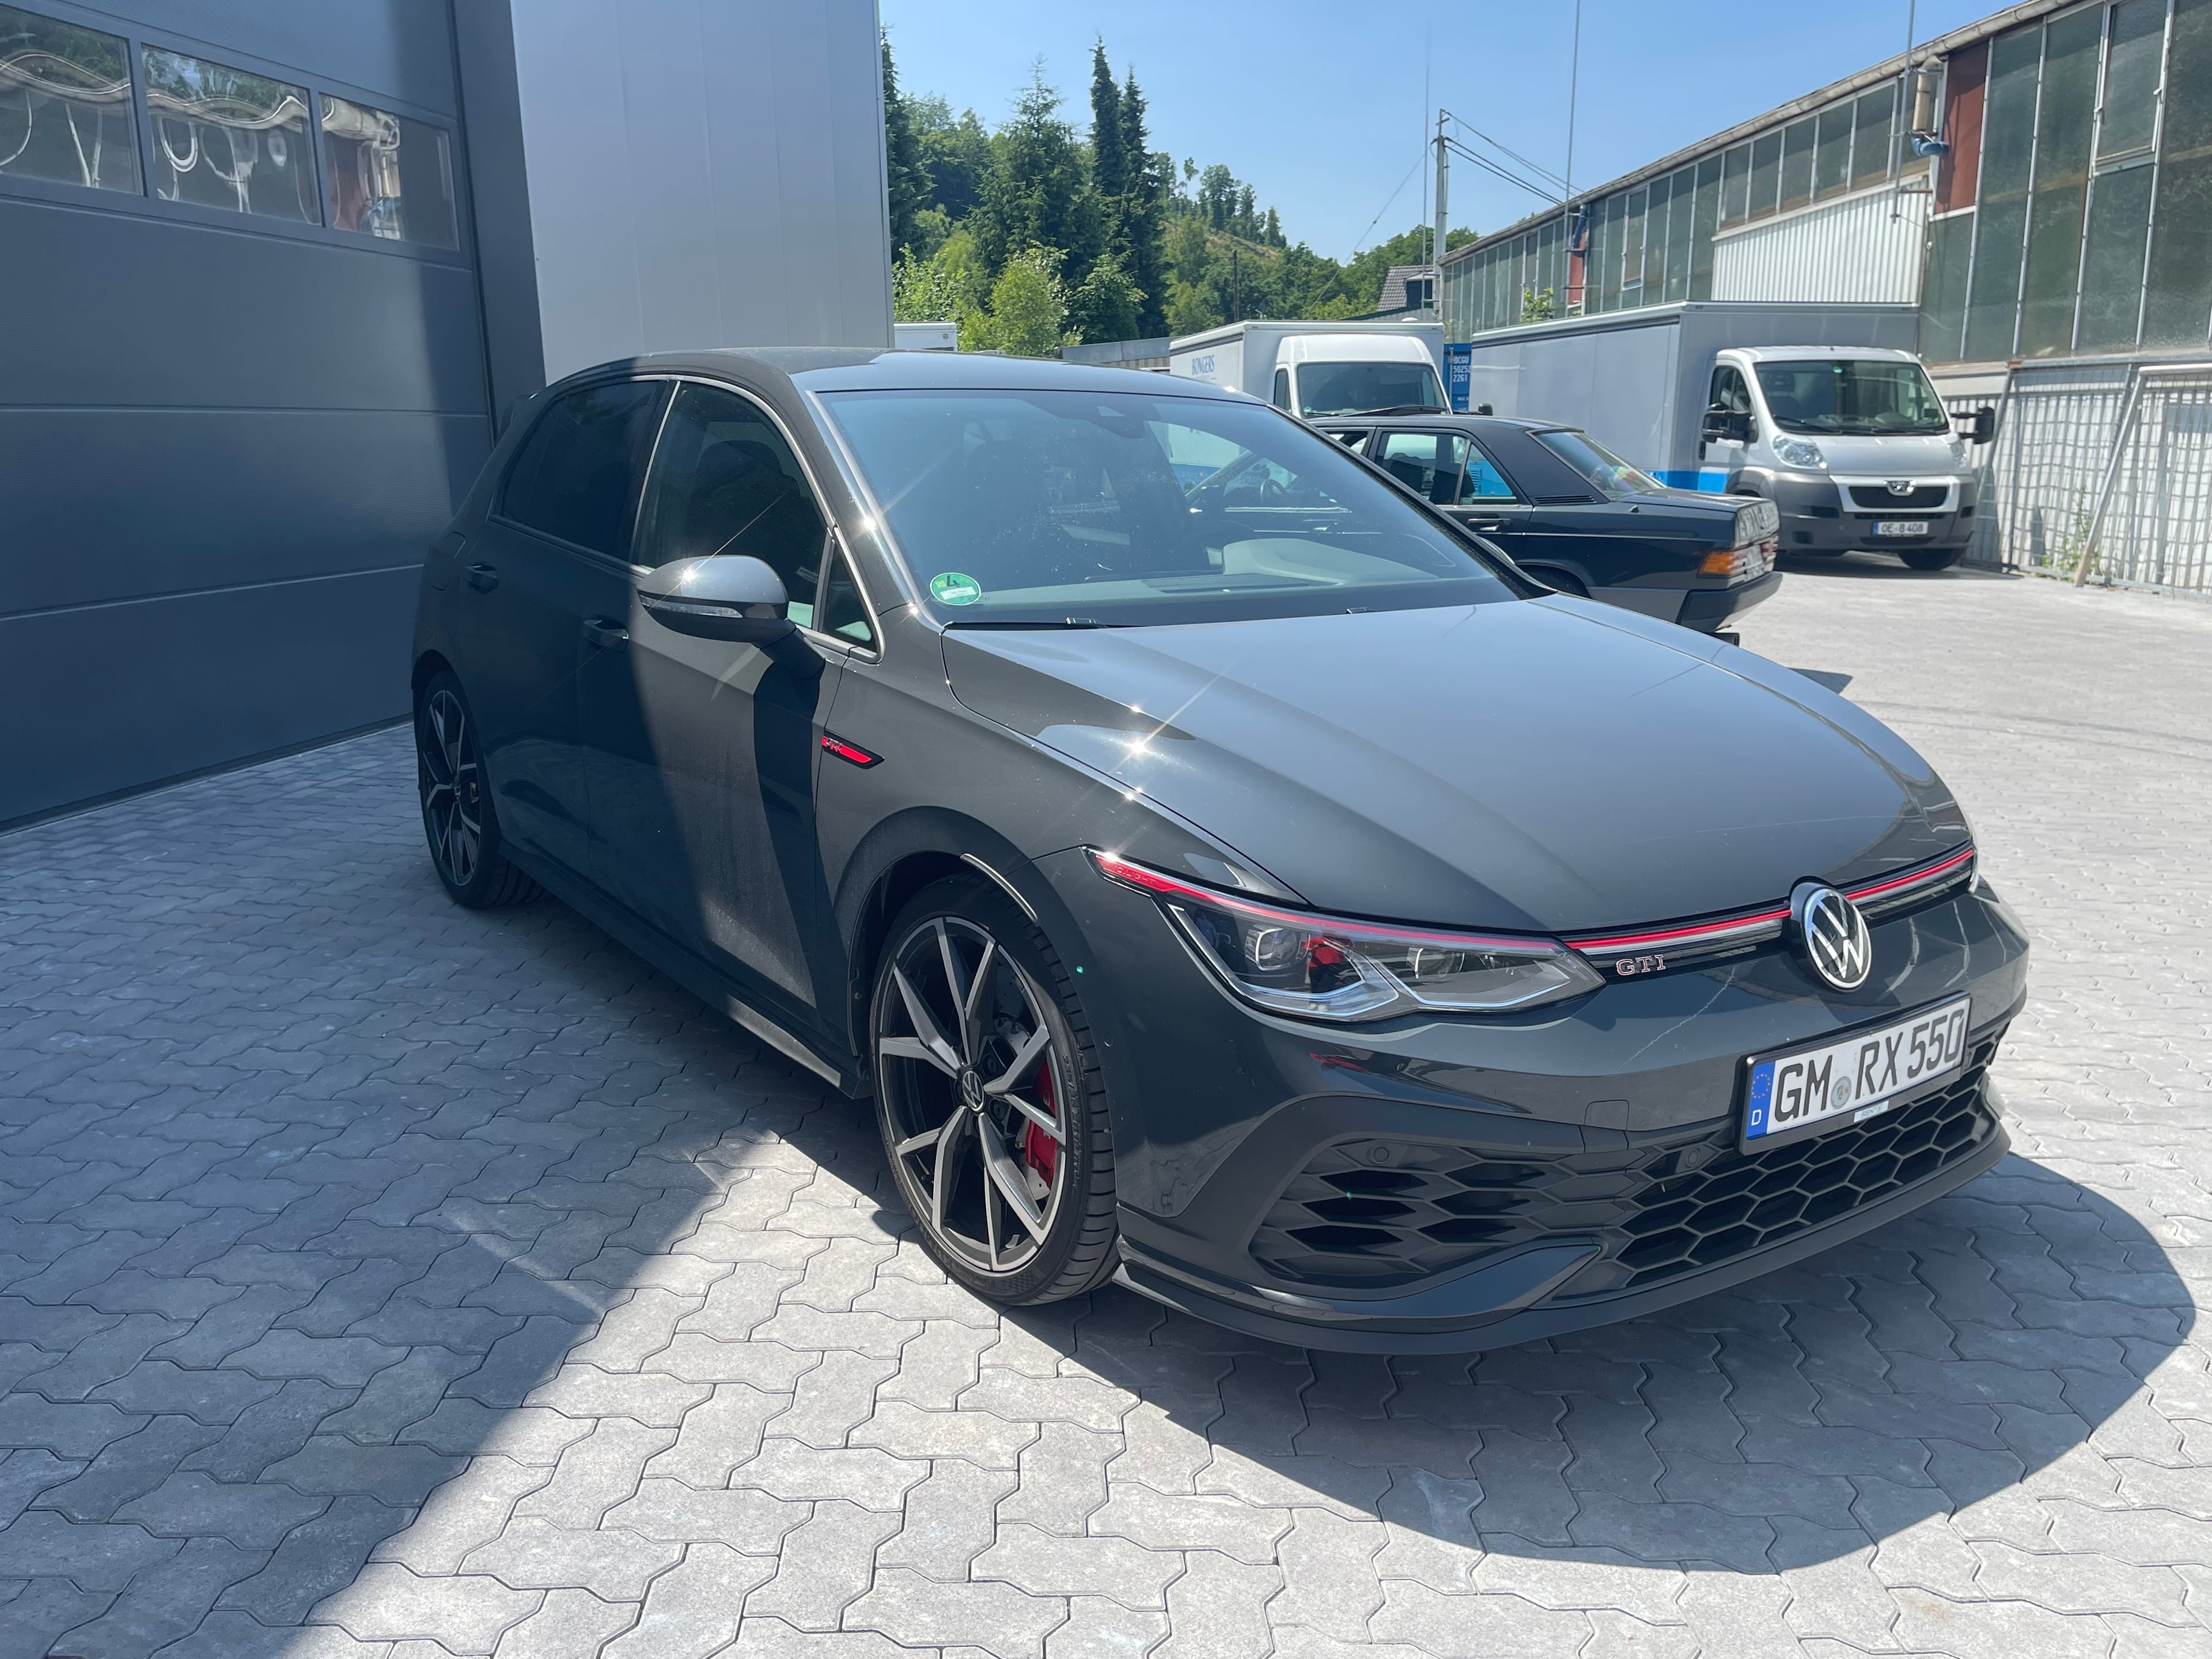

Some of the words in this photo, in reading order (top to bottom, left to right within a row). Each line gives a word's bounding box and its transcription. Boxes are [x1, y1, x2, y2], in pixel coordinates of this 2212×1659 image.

[1616, 954, 1666, 976] GTI
[1774, 1055, 1833, 1122] GM
[1855, 1032, 1903, 1100] RX
[1907, 1009, 1964, 1079] 550
[1751, 1109, 1762, 1126] D
